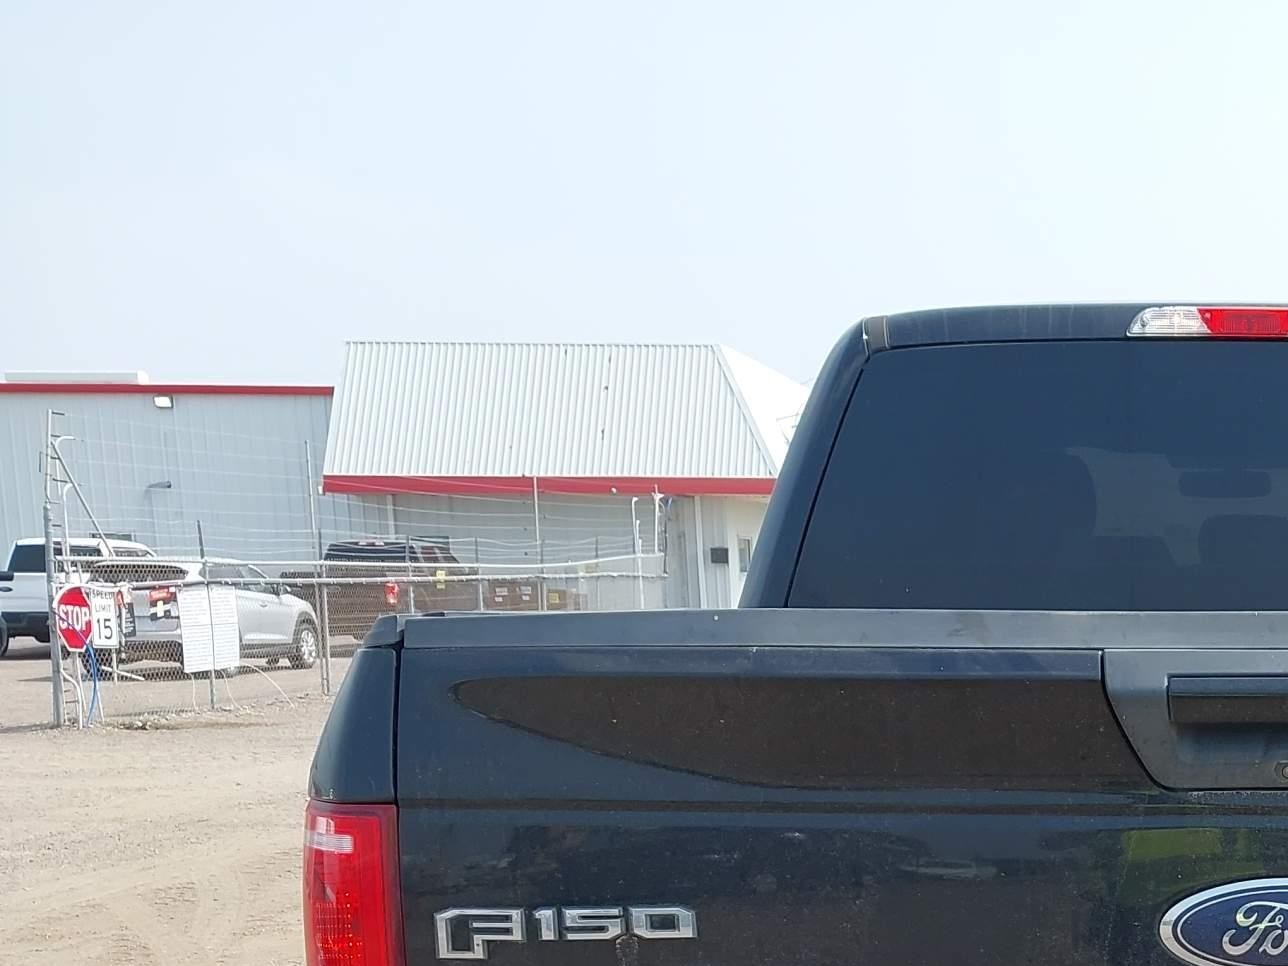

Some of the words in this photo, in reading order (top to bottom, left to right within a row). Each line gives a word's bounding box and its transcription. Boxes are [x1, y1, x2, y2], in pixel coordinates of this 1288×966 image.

[92, 588, 114, 601] SPEED
[95, 602, 112, 614] LIMIT
[60, 604, 90, 631] STOP
[97, 618, 113, 640] 15
